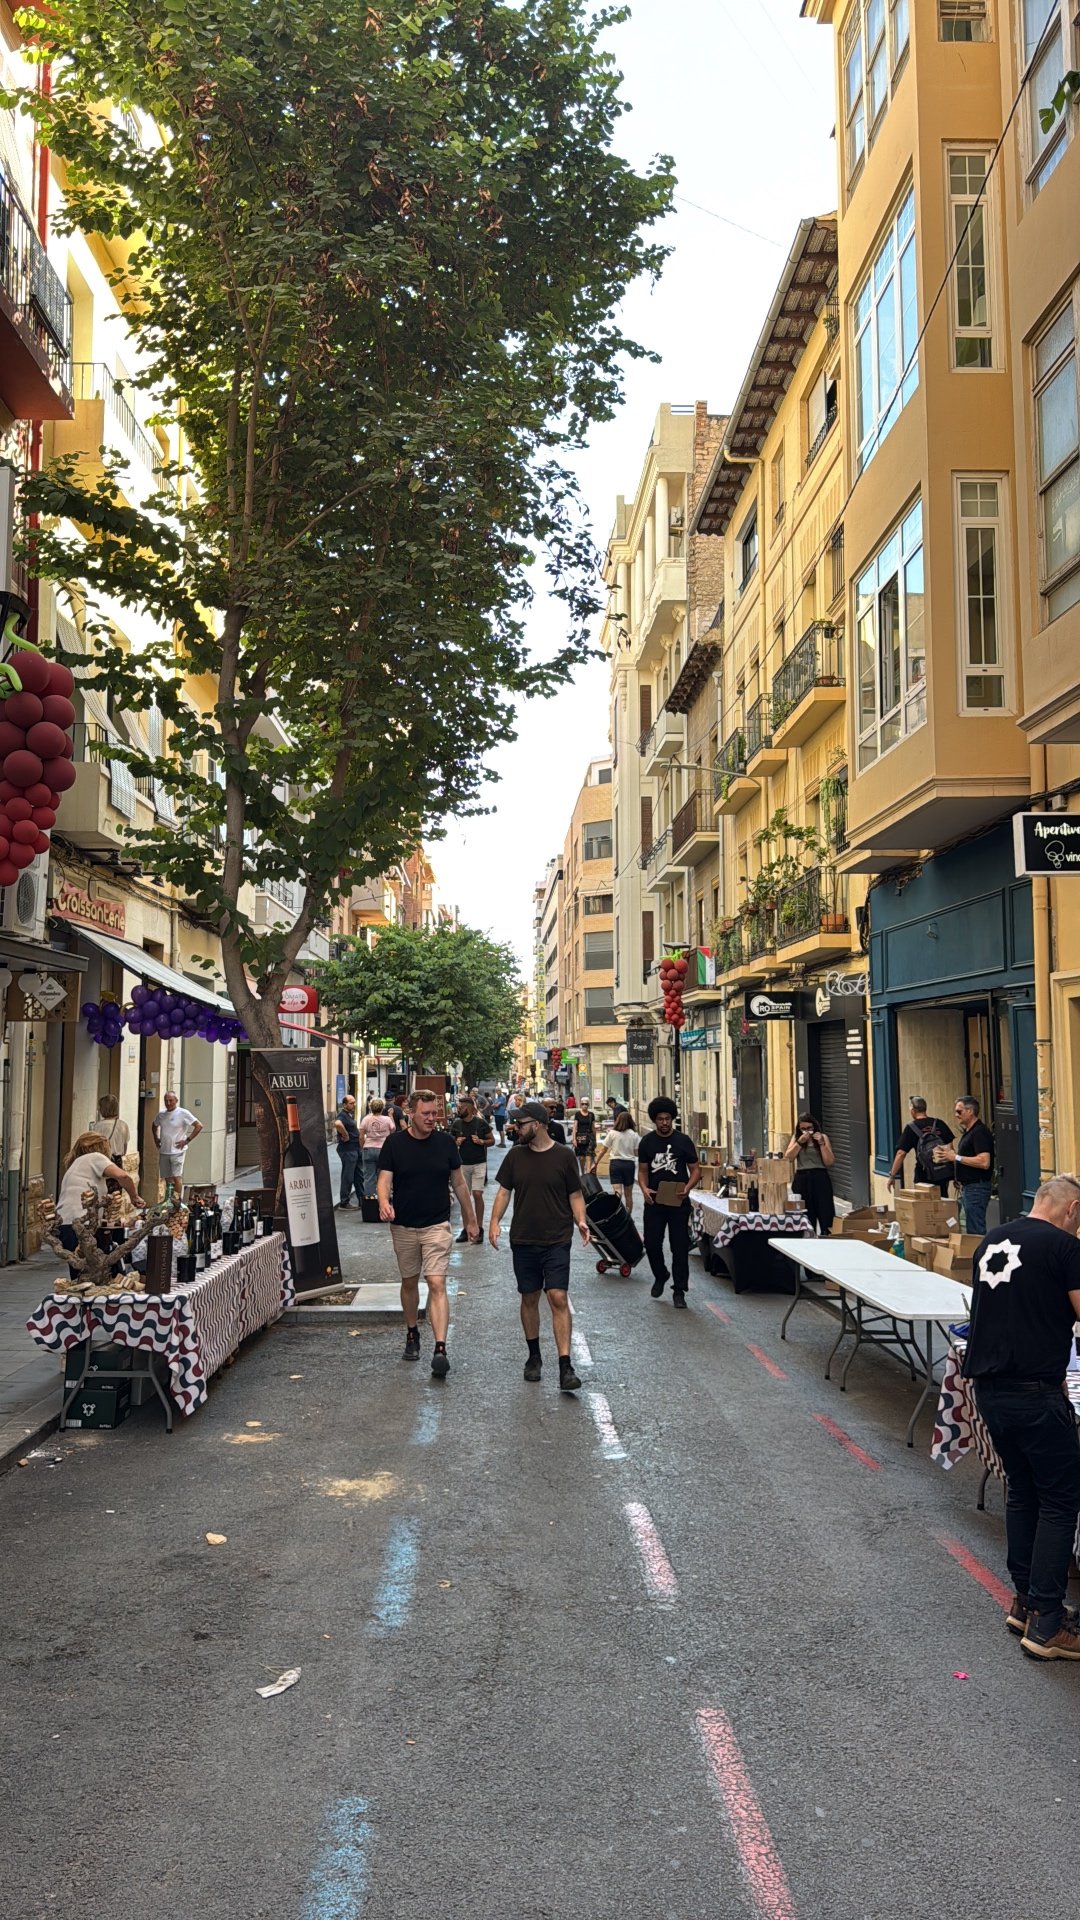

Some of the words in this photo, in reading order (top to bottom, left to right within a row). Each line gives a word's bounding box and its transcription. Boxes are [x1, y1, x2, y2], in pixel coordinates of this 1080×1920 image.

[56, 893, 125, 931] Croissanterie
[271, 1075, 307, 1089] ARBUI
[288, 1179, 312, 1191] ARBUI
